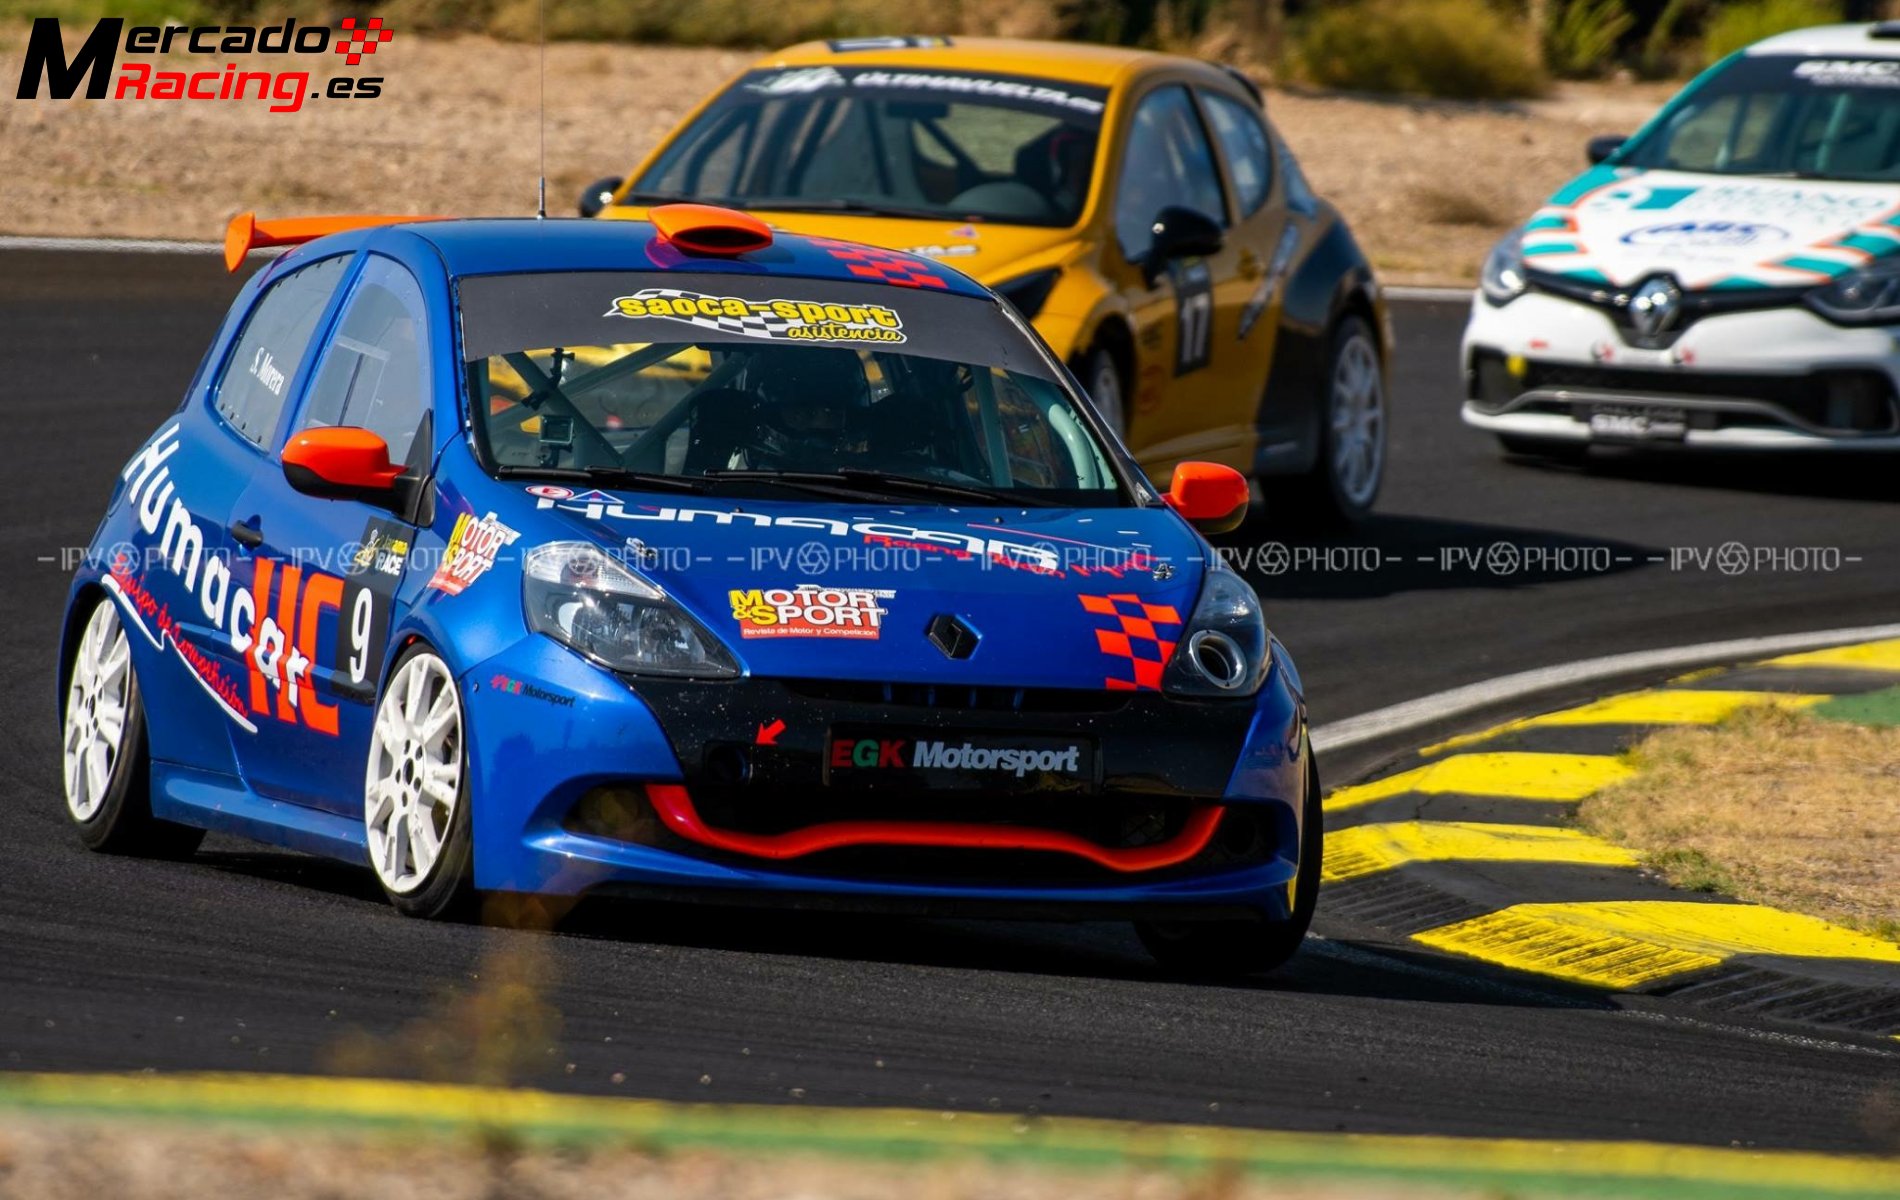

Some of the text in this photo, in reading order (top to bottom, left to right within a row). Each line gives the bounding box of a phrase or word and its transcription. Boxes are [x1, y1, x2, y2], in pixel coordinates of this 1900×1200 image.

[617, 298, 897, 327] saoca-sport
[787, 323, 901, 342] asistencia
[450, 512, 507, 560] MOTOR
[123, 422, 310, 709] Humacar
[729, 588, 877, 608] MOTOR
[348, 587, 373, 685] 9
[789, 627, 814, 636] Motor
[816, 628, 822, 637] y
[831, 740, 1079, 778] EGK Motorsport
